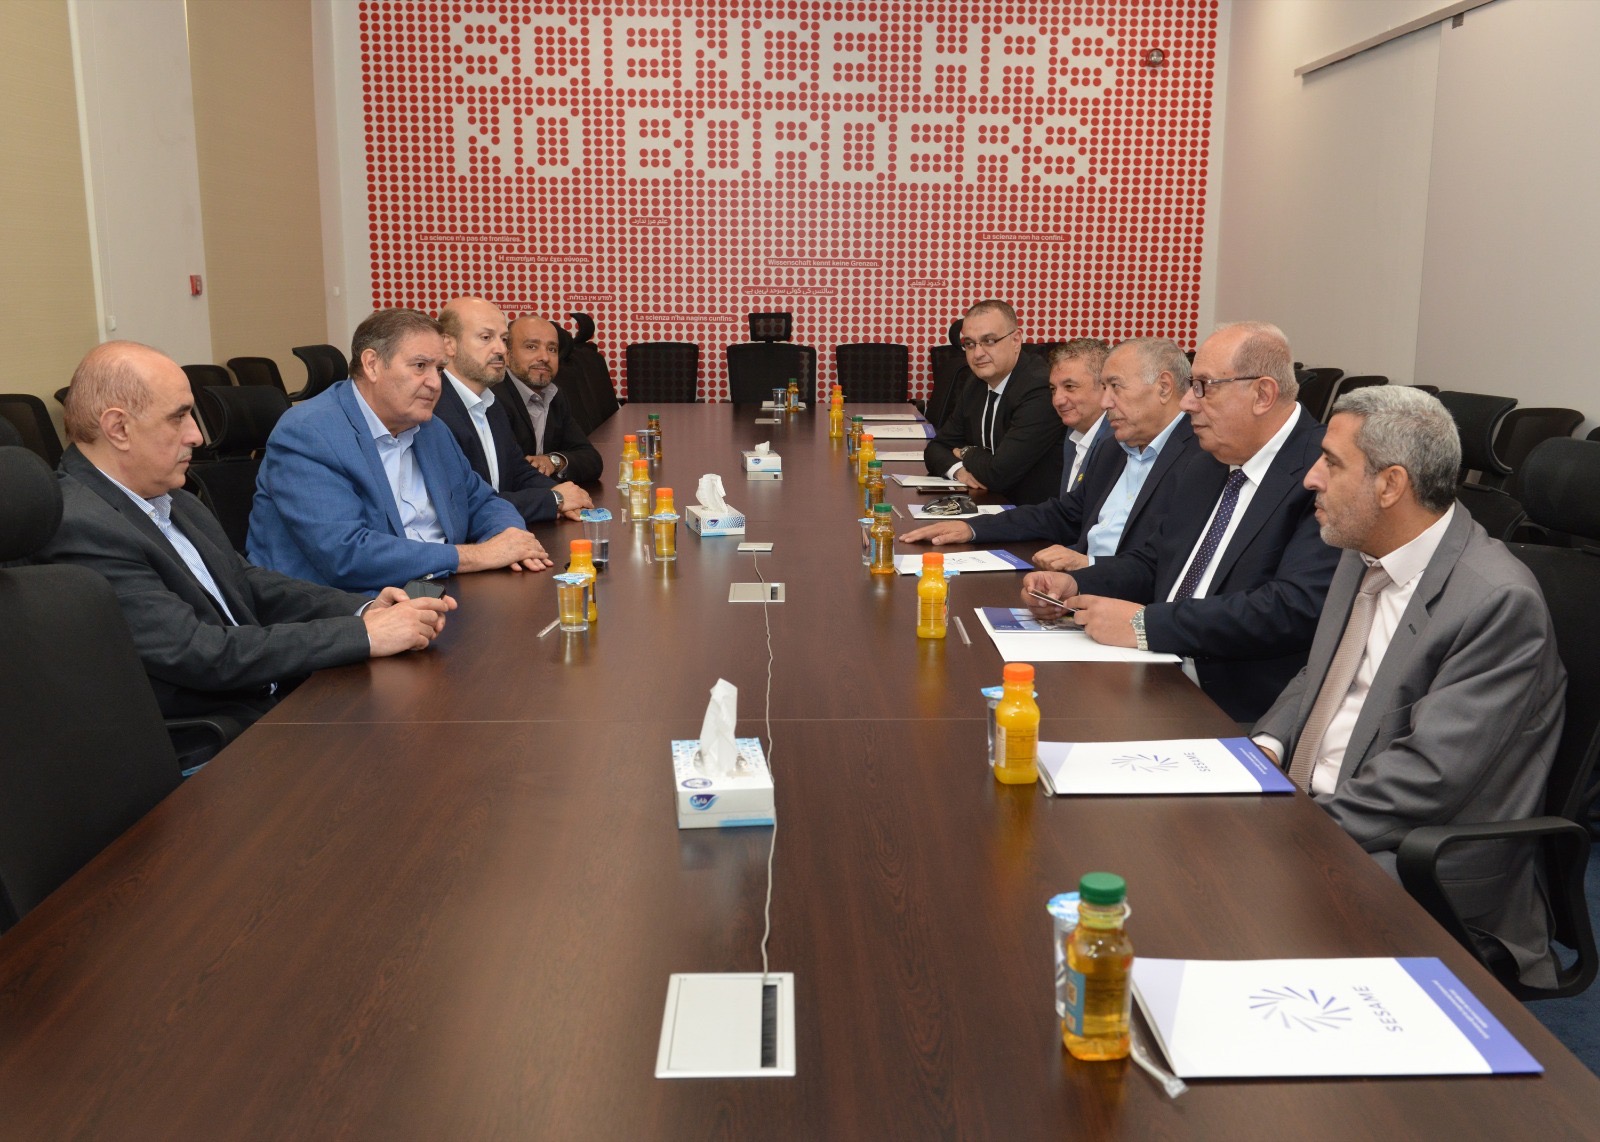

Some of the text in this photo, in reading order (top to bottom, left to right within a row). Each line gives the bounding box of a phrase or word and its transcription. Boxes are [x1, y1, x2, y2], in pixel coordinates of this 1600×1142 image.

[450, 12, 1117, 99] SCIENCE HAS
[454, 104, 1091, 187] NO BORDERS
[429, 234, 454, 242] science
[686, 315, 707, 323] nagins
[1352, 986, 1404, 1032] SESAME
